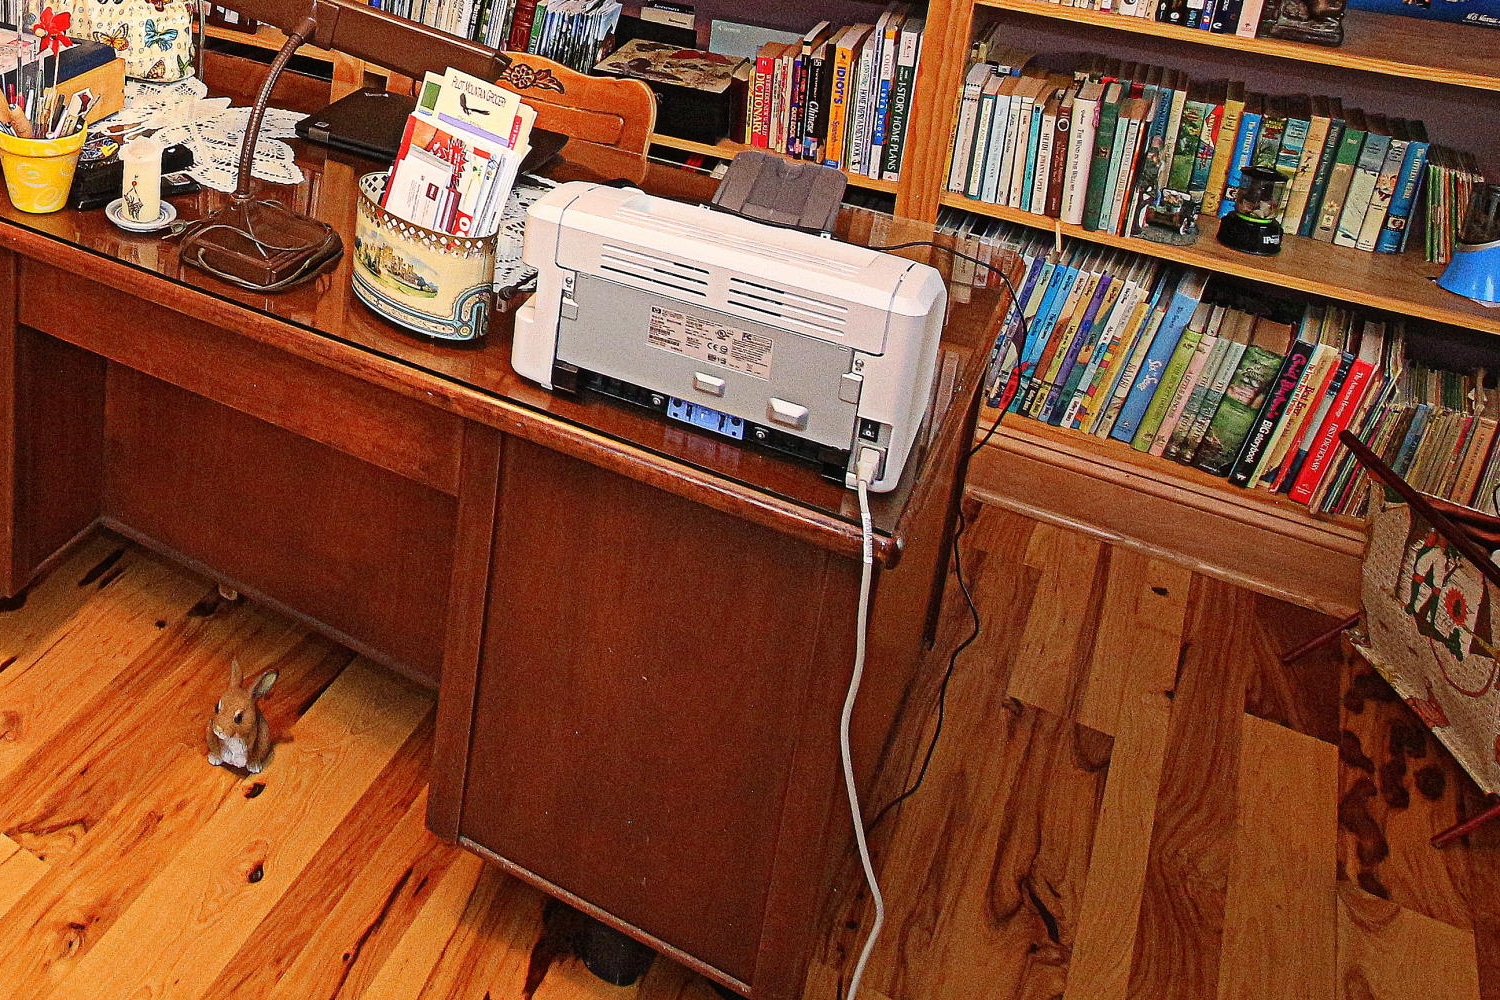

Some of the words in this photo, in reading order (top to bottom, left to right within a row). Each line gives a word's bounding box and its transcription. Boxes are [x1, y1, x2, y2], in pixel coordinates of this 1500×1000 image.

[834, 66, 847, 105] IDIOT'S
[857, 88, 867, 104] HOME
[753, 72, 765, 135] DICTIONARY
[806, 100, 820, 134] Chinese
[854, 105, 866, 141] IMPROVEMENT
[890, 116, 903, 143] HOME
[852, 141, 862, 157] BOOK
[1042, 132, 1052, 151] HEIDI
[886, 143, 899, 170] PLANS
[1118, 363, 1137, 389] BAMBI
[1259, 419, 1274, 434] BIG
[1325, 422, 1340, 438] FIRST
[1244, 433, 1266, 464] storybook
[1310, 437, 1334, 472] DICTIONARY
